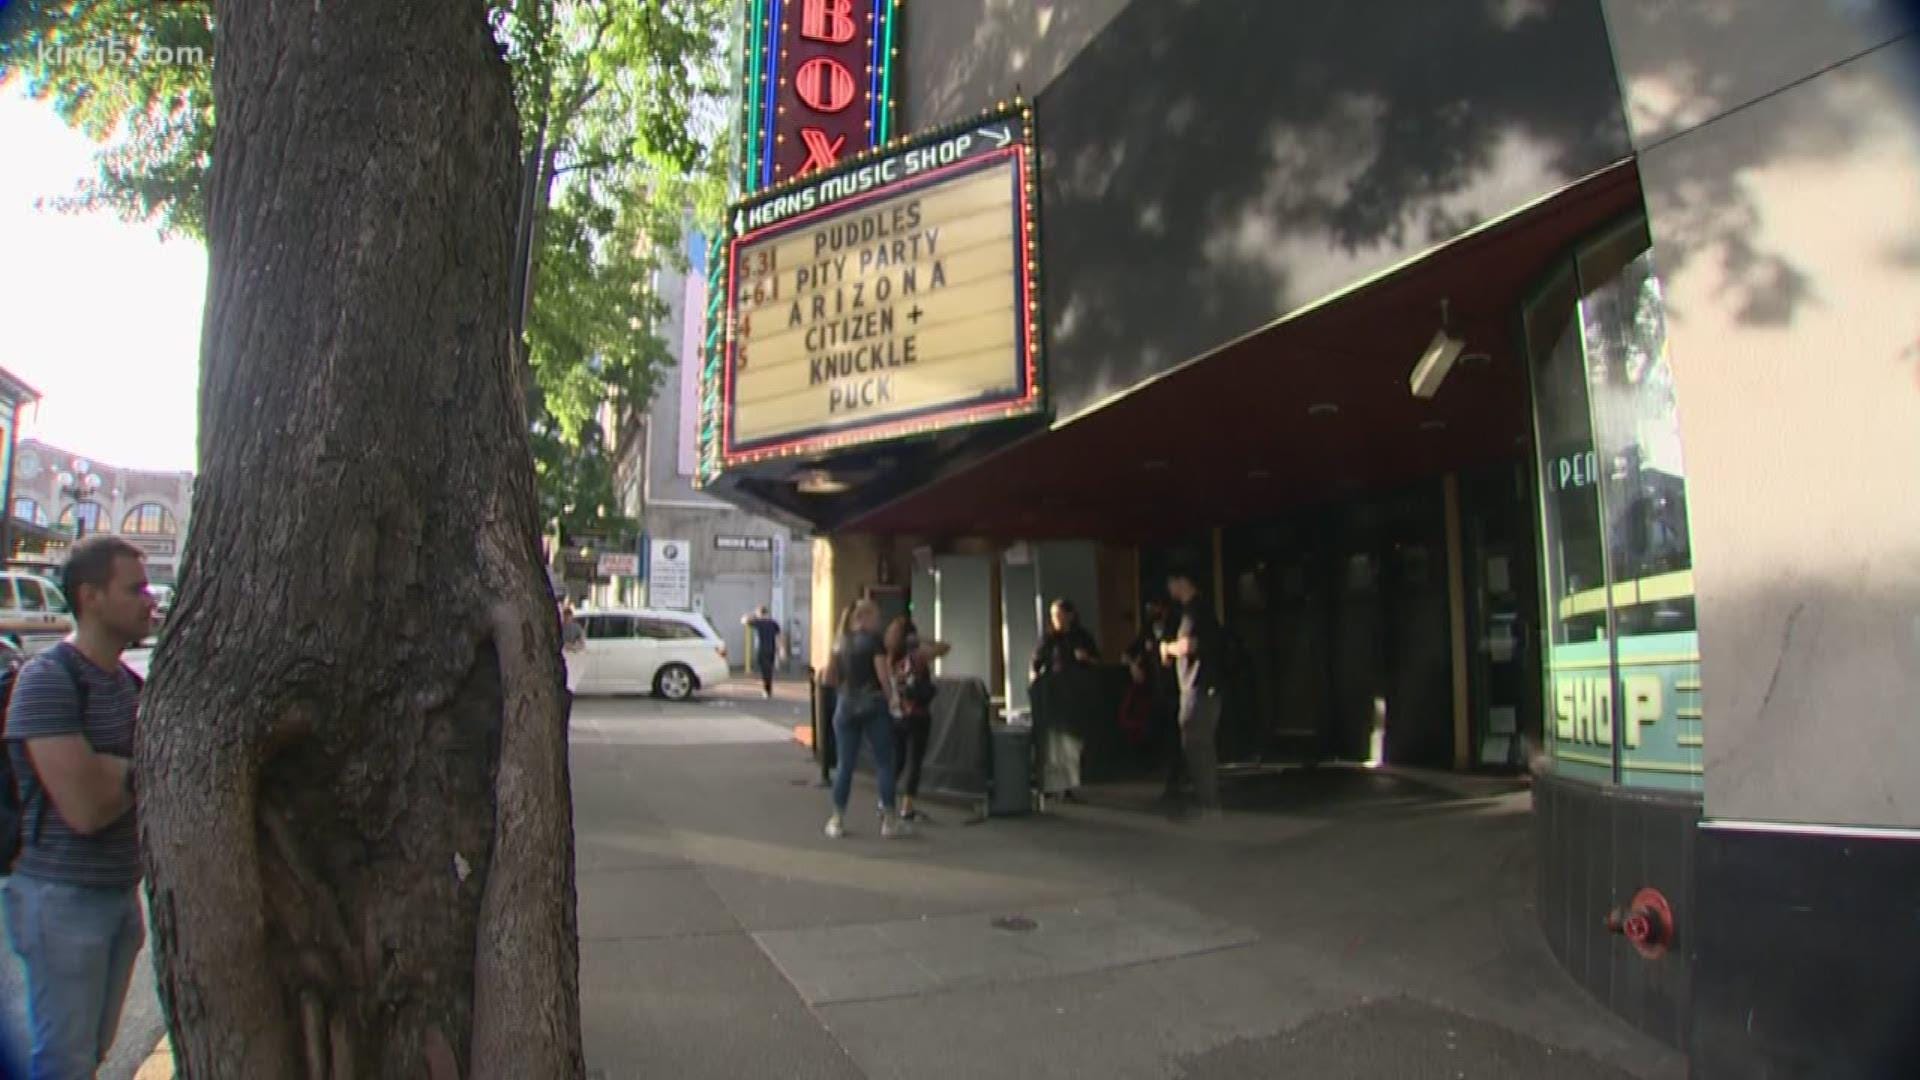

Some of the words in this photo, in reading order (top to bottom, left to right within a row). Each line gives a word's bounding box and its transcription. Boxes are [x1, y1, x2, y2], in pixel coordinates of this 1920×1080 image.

[820, 157, 898, 203] MUSIC
[905, 134, 972, 175] SHOP
[814, 203, 922, 255] PUDDLES
[796, 258, 847, 293] PITY
[859, 227, 940, 274] PARTY
[804, 306, 896, 352] CITIZEN
[809, 336, 917, 385] KNUCKLE
[829, 378, 892, 413] PUCK
[1556, 672, 1663, 750] SHOP
